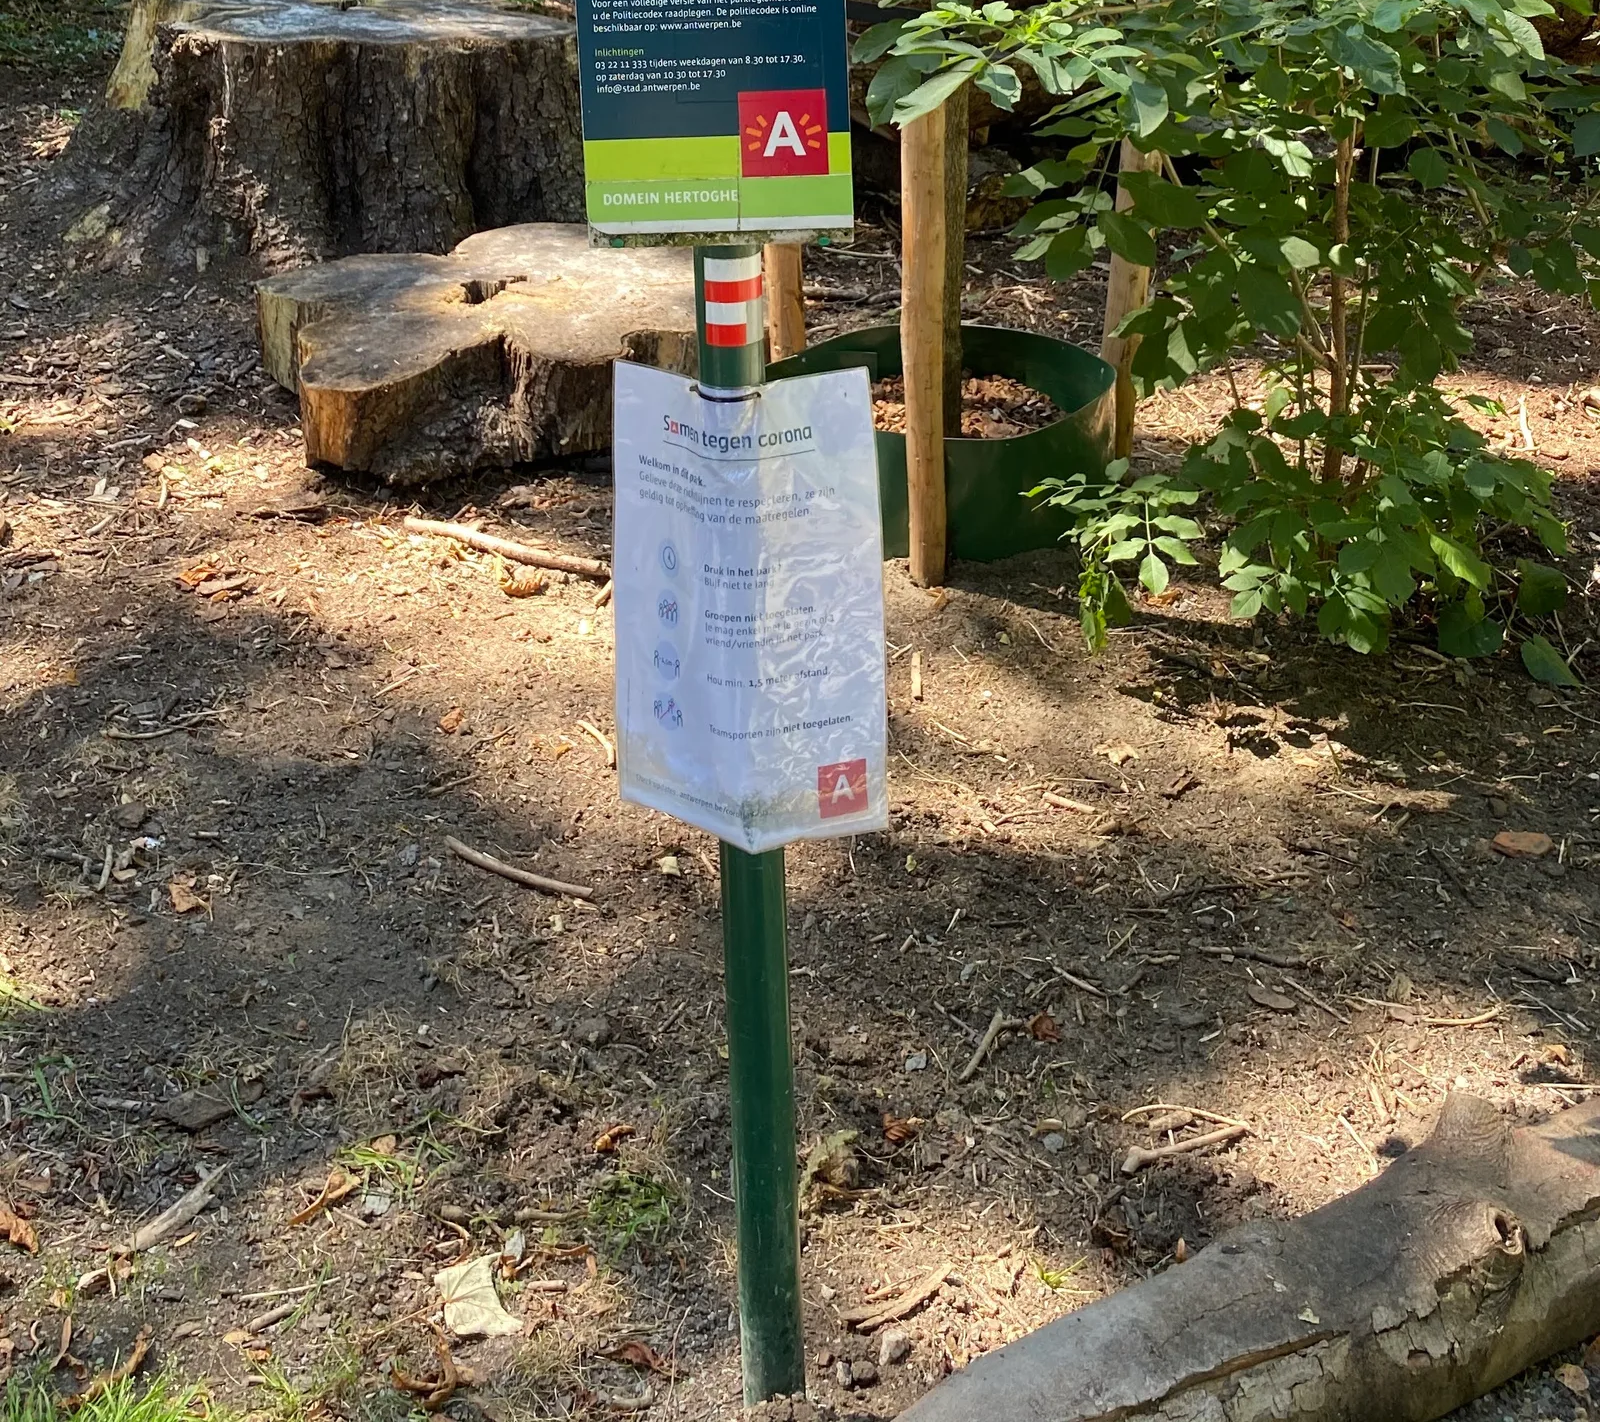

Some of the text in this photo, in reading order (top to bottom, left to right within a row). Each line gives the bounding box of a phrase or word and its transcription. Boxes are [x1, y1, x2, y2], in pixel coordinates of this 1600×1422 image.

[600, 12, 610, 20] de
[613, 10, 662, 19] Politiecodex
[665, 9, 714, 18] raadplegen.
[717, 8, 727, 16] De
[730, 6, 780, 17] politiecodex
[791, 5, 816, 13] online
[594, 23, 642, 32] beschikbaar
[660, 20, 741, 30] www.antwerpen.be
[595, 48, 644, 57] Inlichtingen
[596, 62, 605, 70] 03
[632, 60, 647, 69] 333
[650, 59, 677, 68] tijdens
[679, 57, 726, 66] weekdagen
[746, 56, 763, 64] 8.30
[780, 55, 805, 63] 17.30,
[609, 72, 644, 81] zaterdag
[664, 71, 686, 79] 10.30
[703, 70, 725, 78] 17.30
[597, 82, 700, 94] info@stad.antwerpen.be
[763, 111, 806, 157] A
[604, 190, 738, 205] DOMEIN HERTOGHE
[702, 430, 752, 453] tegen
[758, 426, 812, 447] corona
[639, 454, 670, 472] Welkom
[672, 464, 679, 474] in
[725, 498, 734, 507] te
[805, 490, 815, 499] ze
[640, 489, 663, 504] geldig
[708, 514, 725, 523] van
[729, 514, 741, 524] de
[704, 564, 723, 576] Druk
[727, 567, 735, 576] in
[738, 567, 754, 576] het
[704, 610, 742, 623] Groepen
[707, 674, 723, 686] Hou
[748, 679, 763, 688] 1,5
[709, 724, 763, 740] Teamsporten
[783, 723, 800, 734] niet
[803, 715, 853, 729] toegelaten.
[831, 774, 855, 804] A
